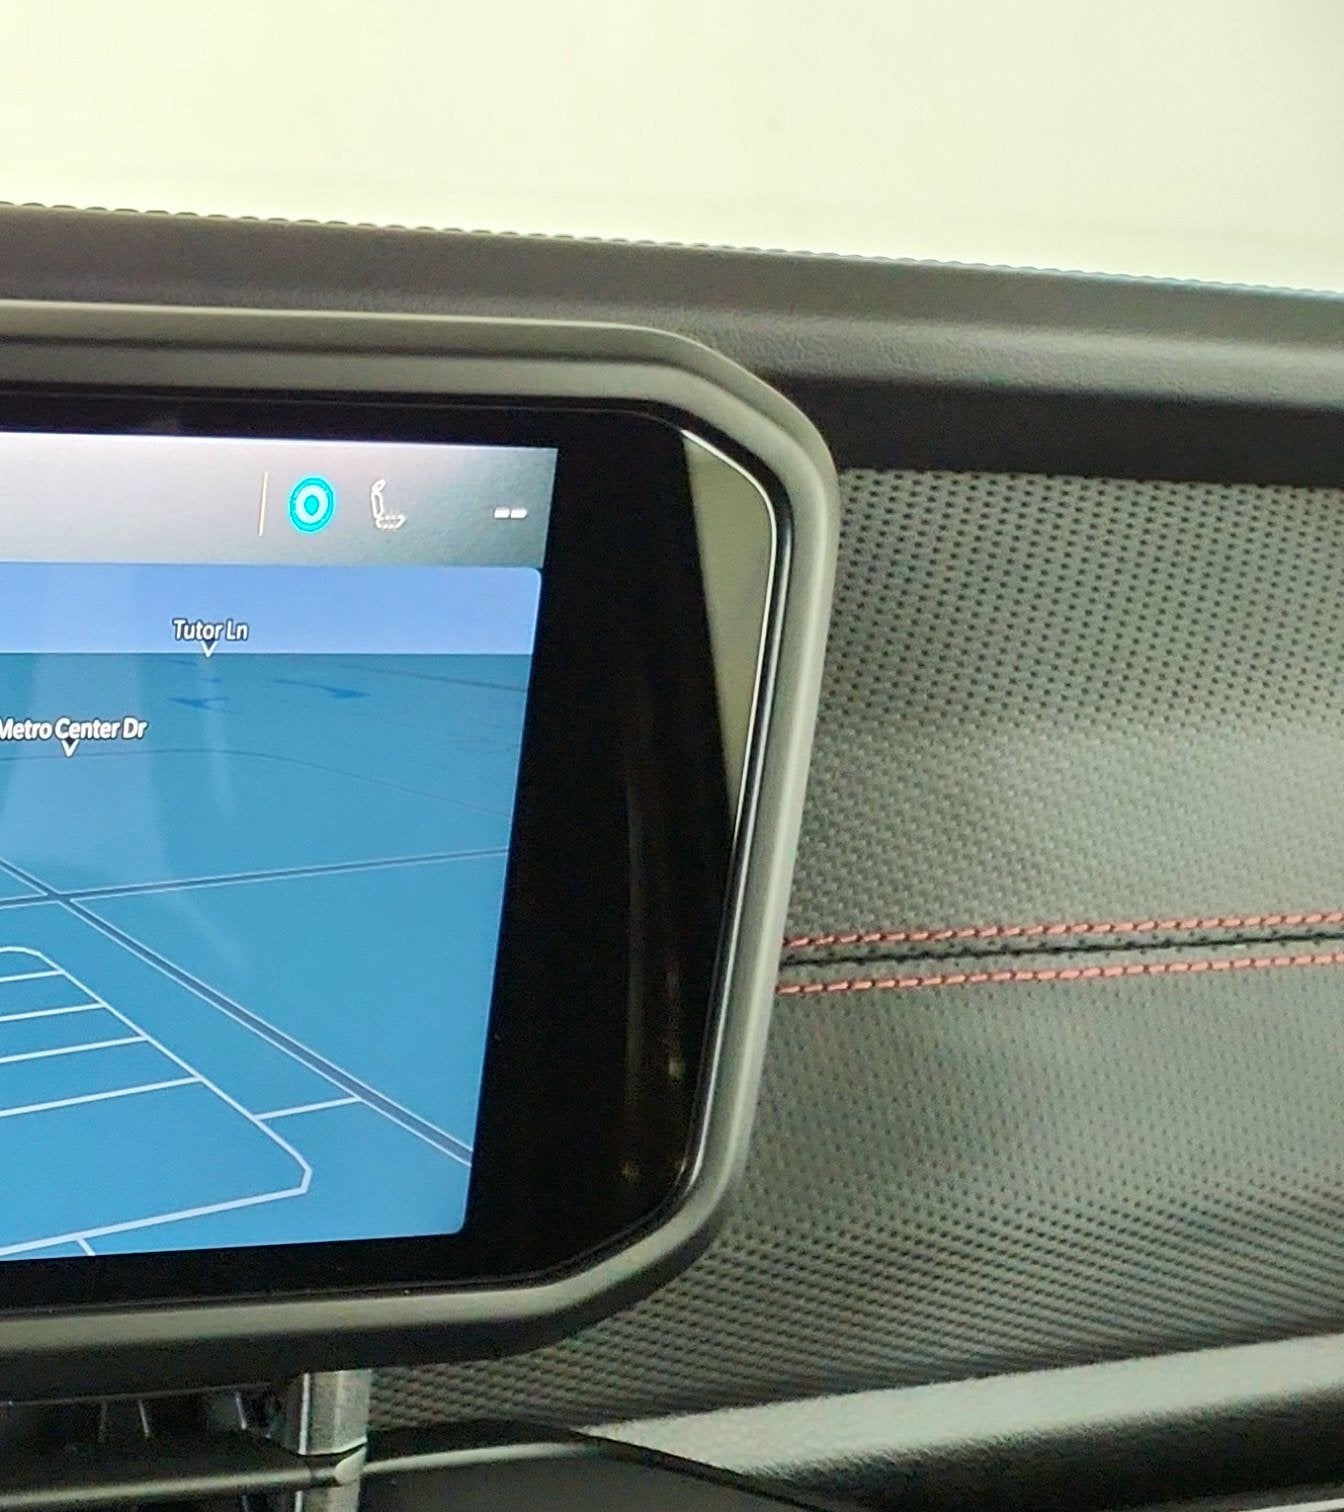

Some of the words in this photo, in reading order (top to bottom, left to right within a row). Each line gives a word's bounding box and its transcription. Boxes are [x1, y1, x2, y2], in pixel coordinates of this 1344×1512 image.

[172, 618, 223, 642] Tutor
[225, 620, 249, 642] Ln
[54, 717, 119, 742] Center
[121, 719, 149, 741] Dr
